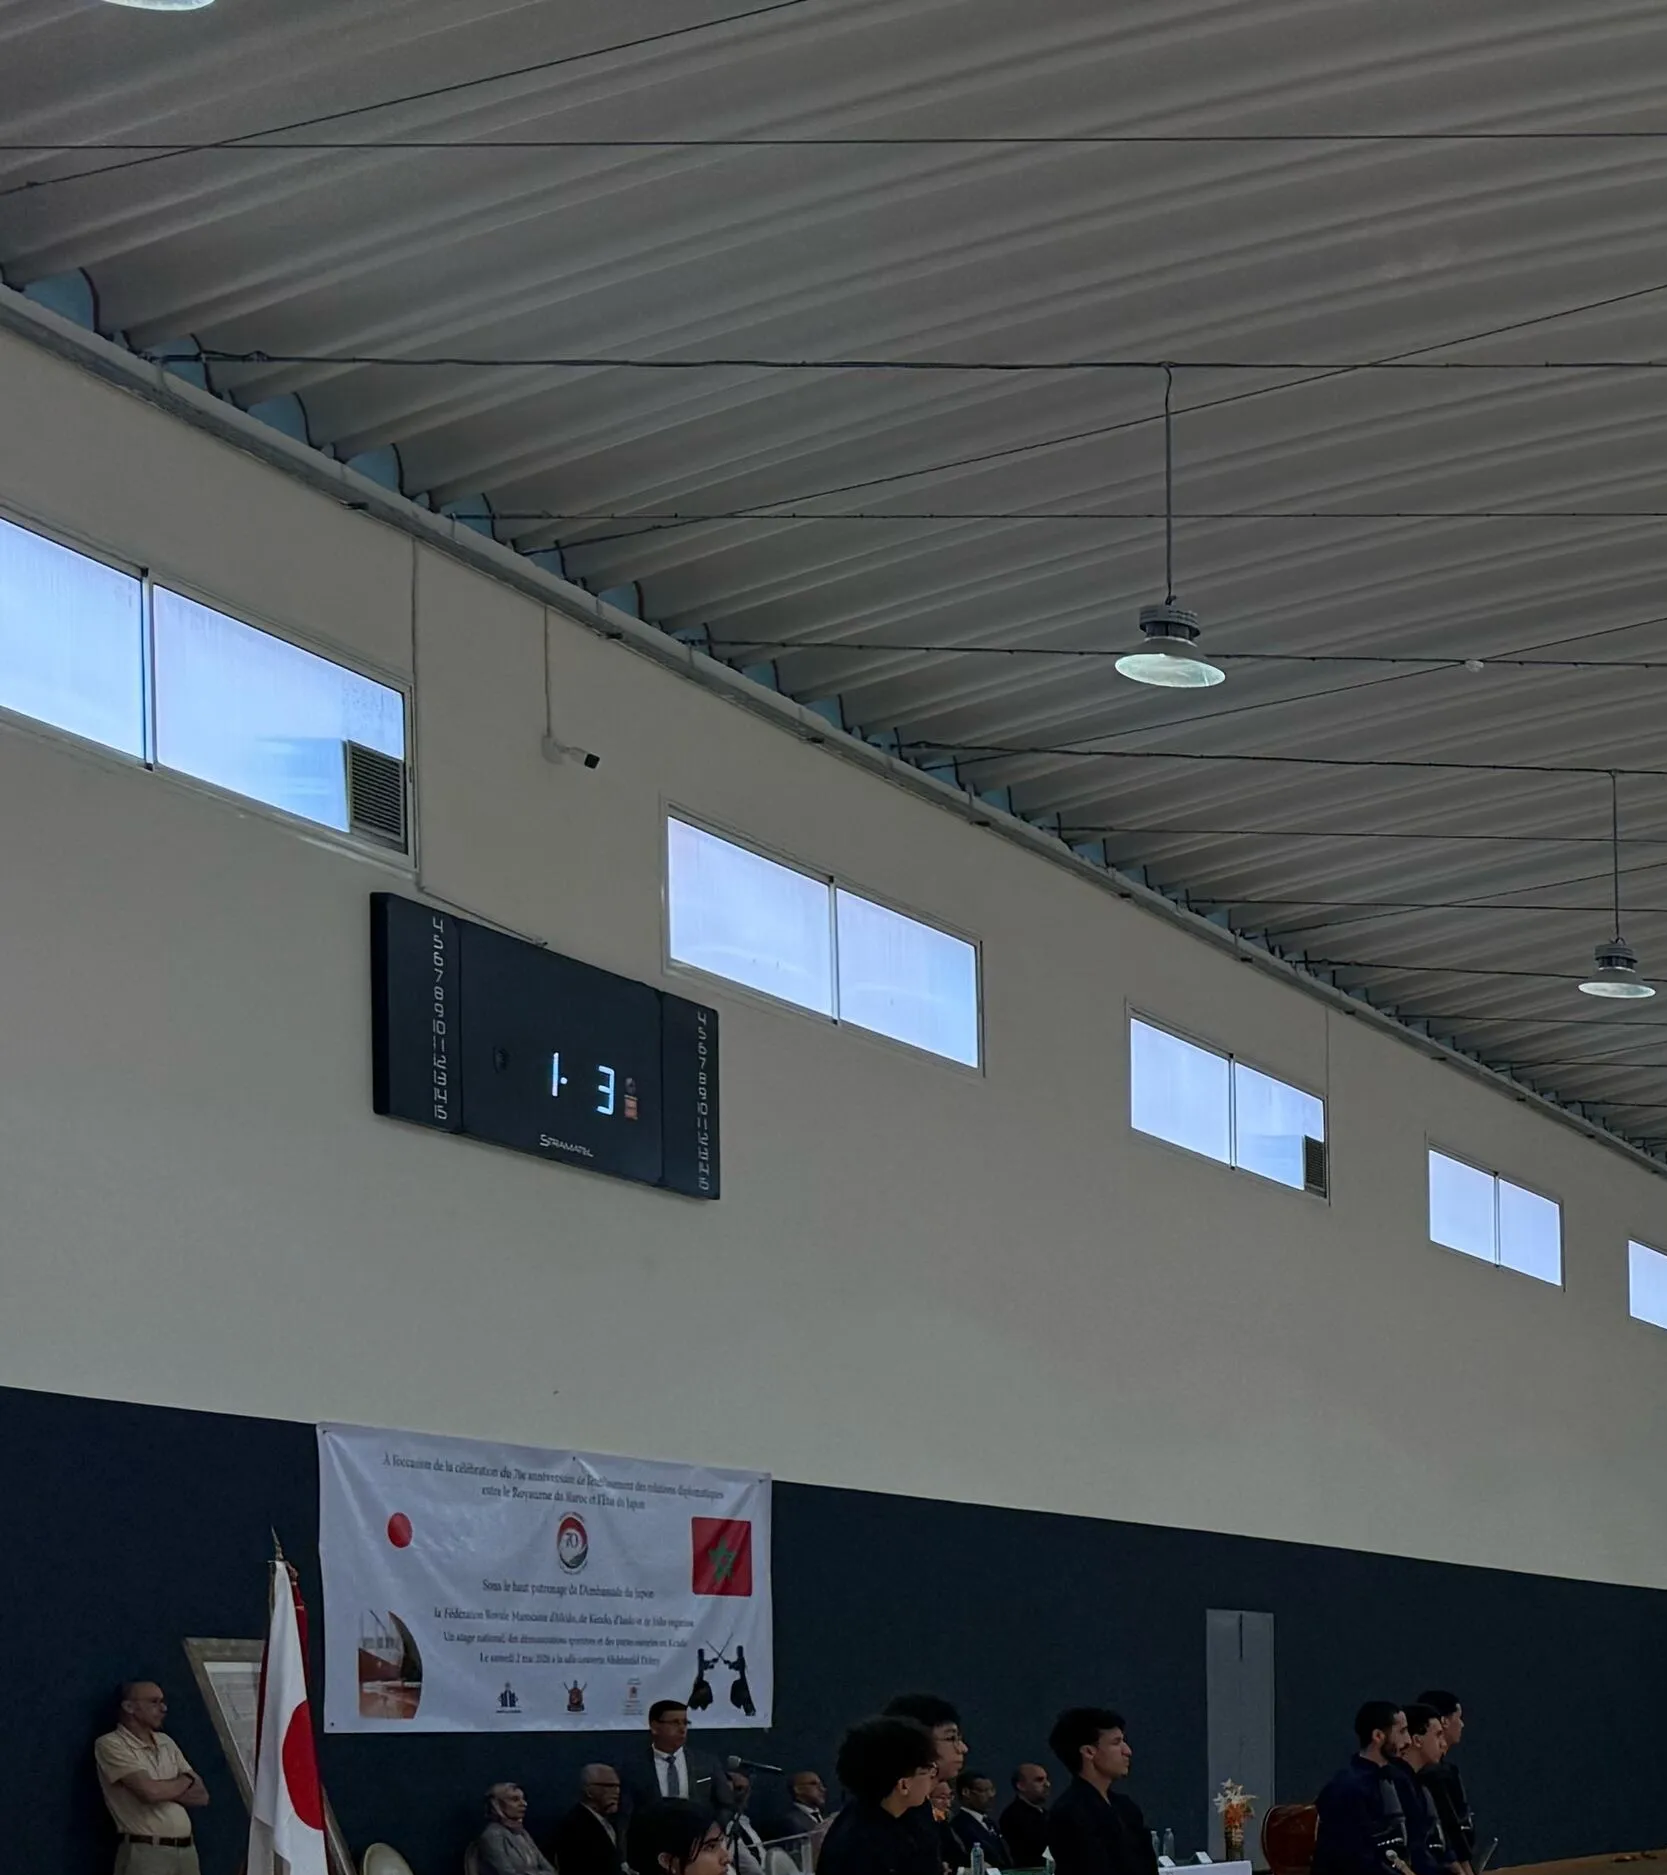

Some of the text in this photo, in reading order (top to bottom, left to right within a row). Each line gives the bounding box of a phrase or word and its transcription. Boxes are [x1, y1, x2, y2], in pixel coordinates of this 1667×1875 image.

[433, 917, 444, 933] 4
[434, 934, 444, 951] 5
[433, 951, 444, 967] 6
[434, 967, 444, 983] 7
[434, 986, 444, 1001] 8
[434, 1003, 444, 1018] 9
[433, 1458, 444, 1471] de
[446, 1456, 453, 1472] la
[500, 1465, 512, 1479] du
